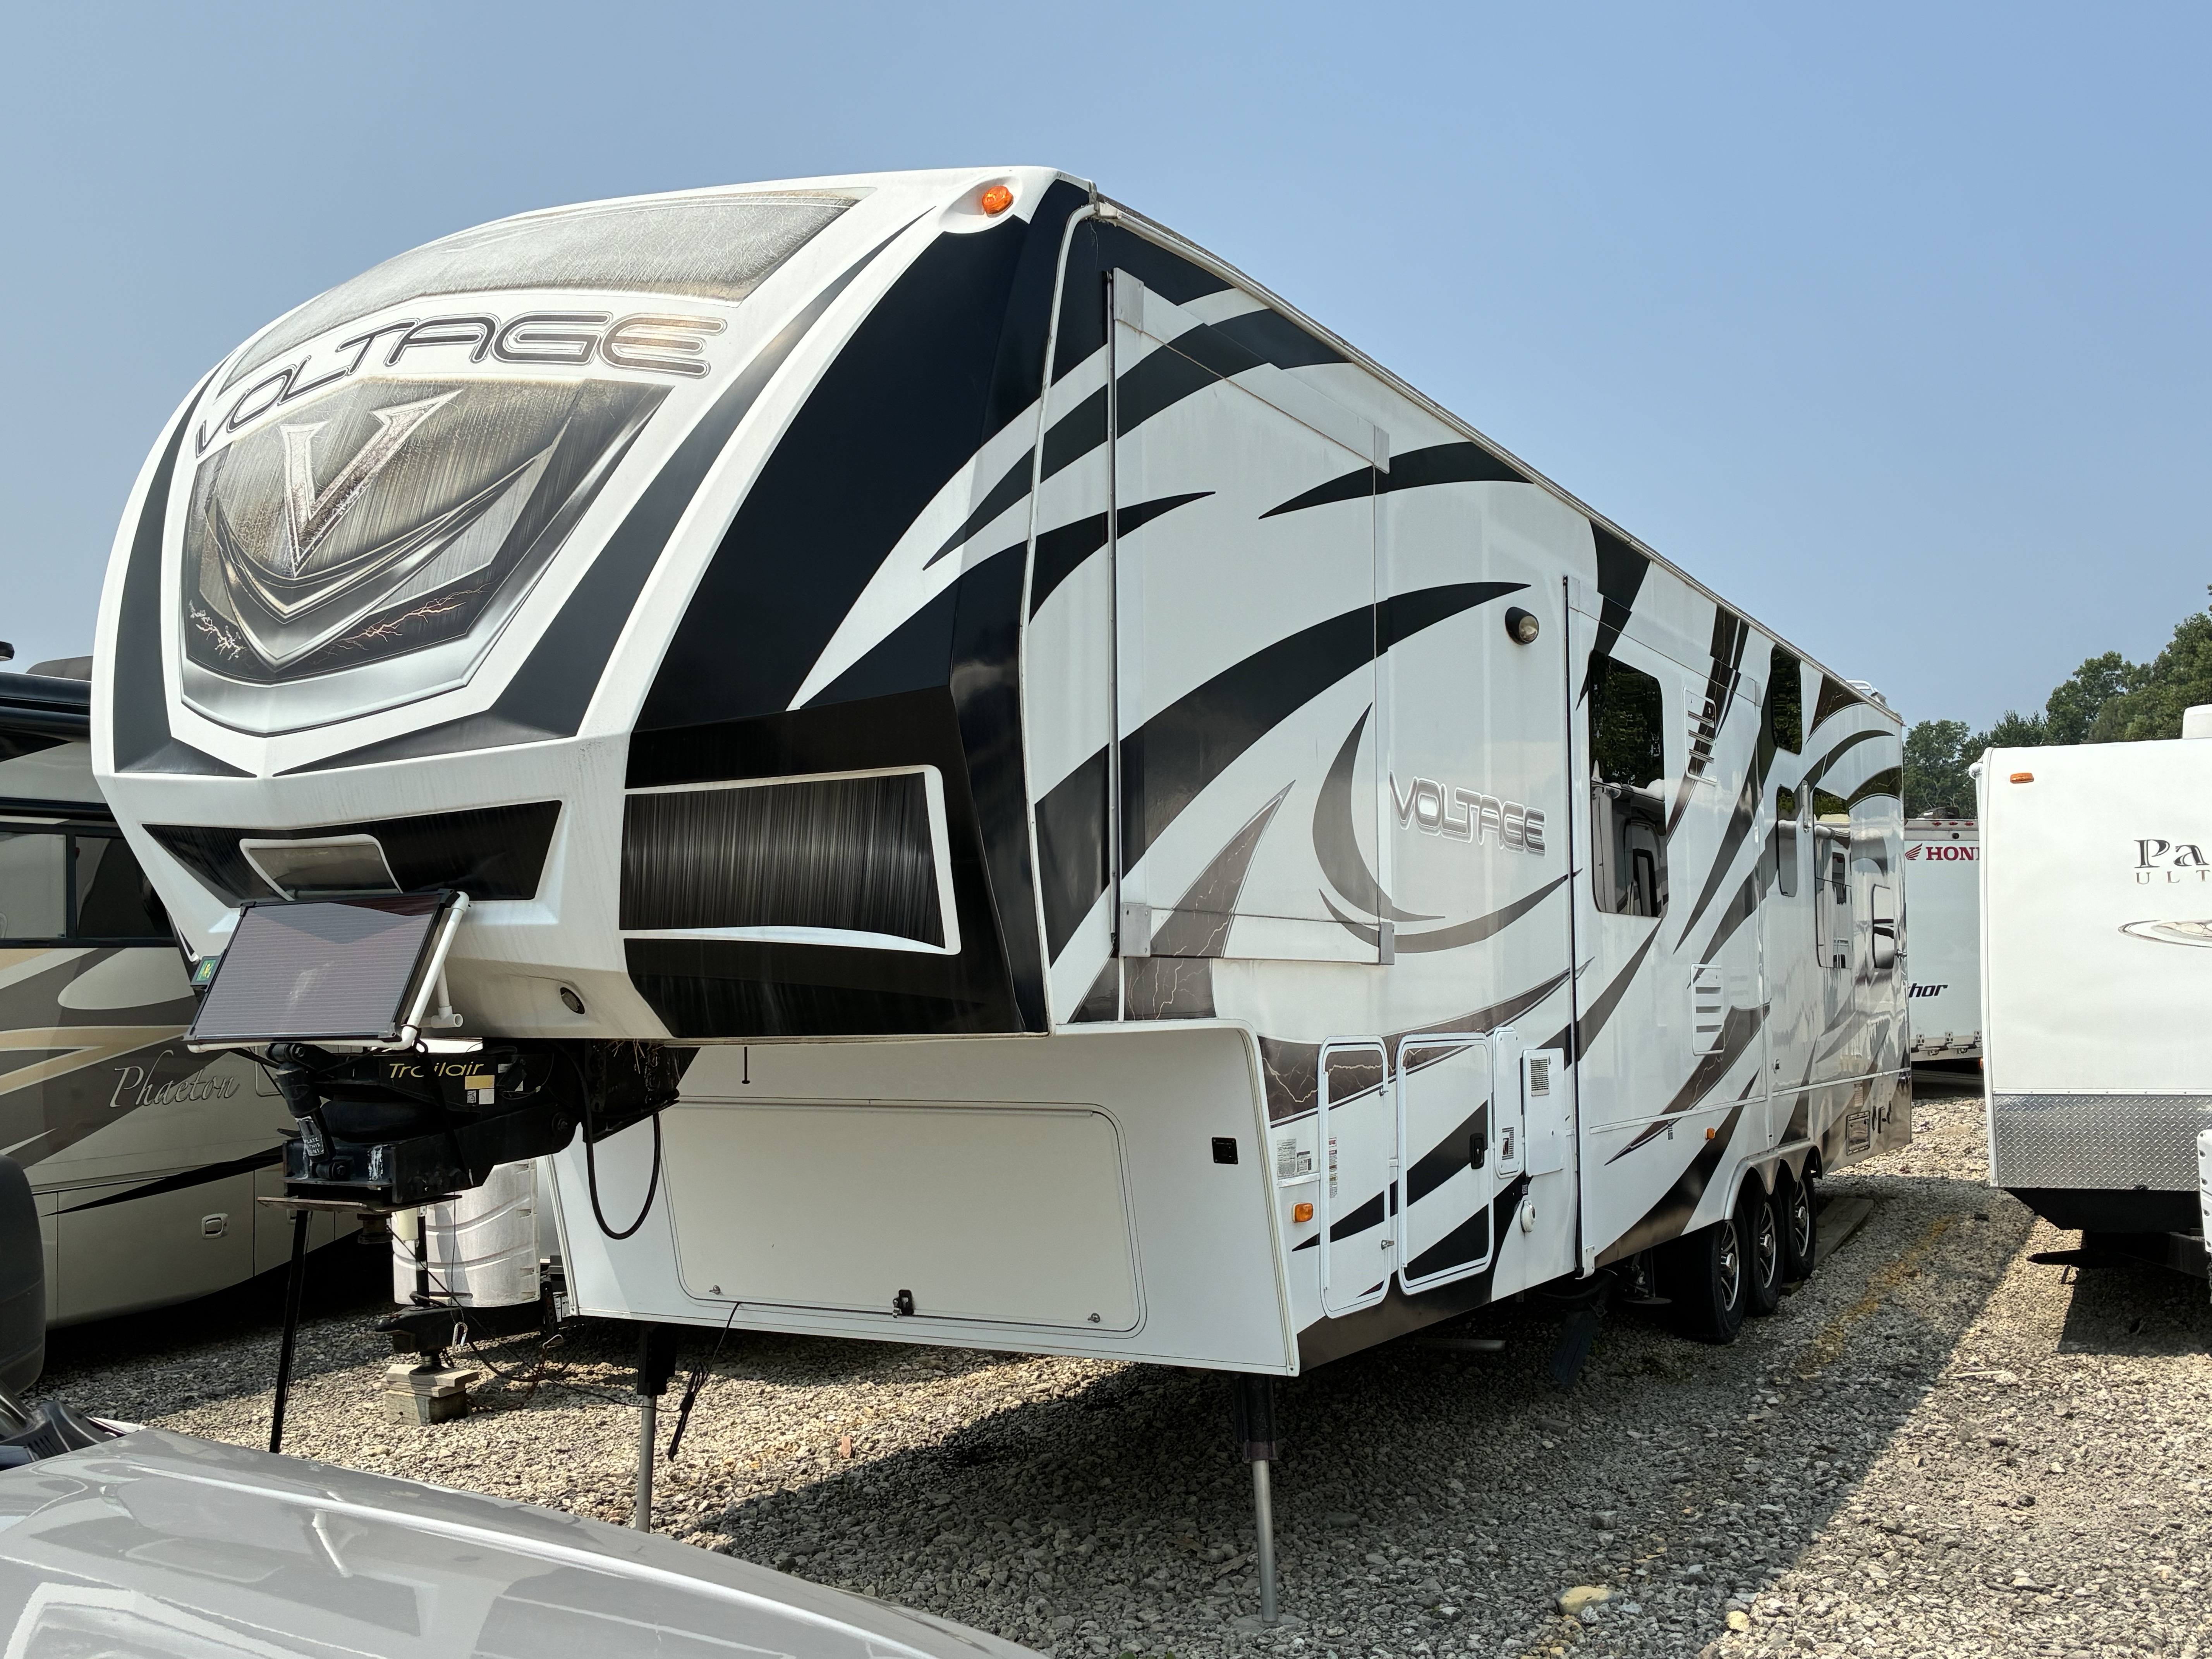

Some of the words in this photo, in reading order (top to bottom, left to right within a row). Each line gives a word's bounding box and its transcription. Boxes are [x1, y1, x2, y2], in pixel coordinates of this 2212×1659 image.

[195, 311, 727, 459] VOLTAGE
[276, 389, 464, 578] V
[1389, 770, 1546, 857] VOLTAGE
[2134, 839, 2210, 868] Pa
[1908, 983, 1948, 998] hor
[110, 1049, 240, 1107] Phaeton
